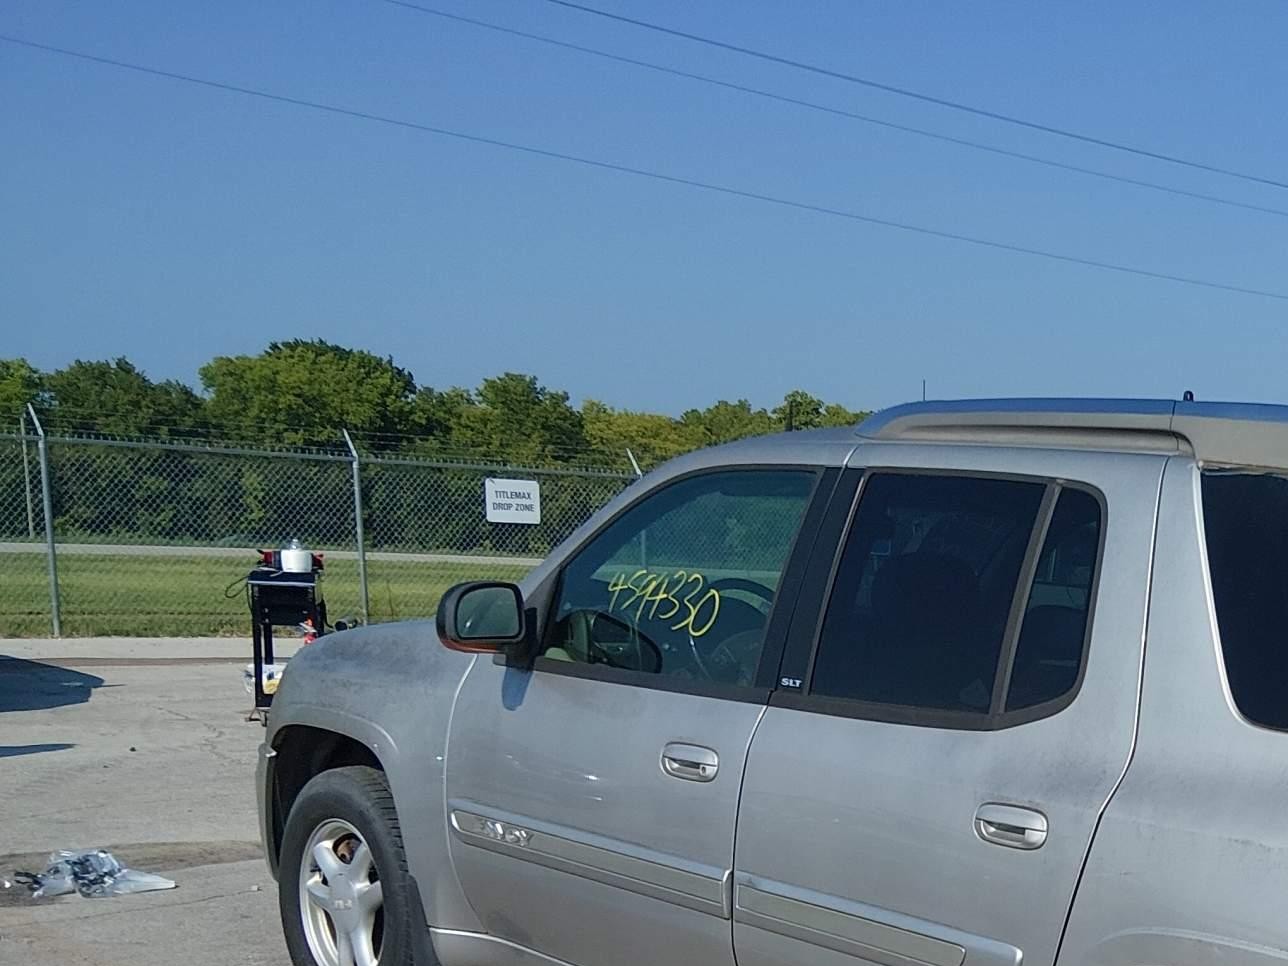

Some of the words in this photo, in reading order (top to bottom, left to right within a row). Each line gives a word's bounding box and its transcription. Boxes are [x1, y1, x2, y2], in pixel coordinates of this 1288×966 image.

[494, 490, 533, 500] TITLEMAX
[492, 502, 513, 511] DROP
[515, 503, 535, 512] ZONE
[781, 677, 803, 688] SLT
